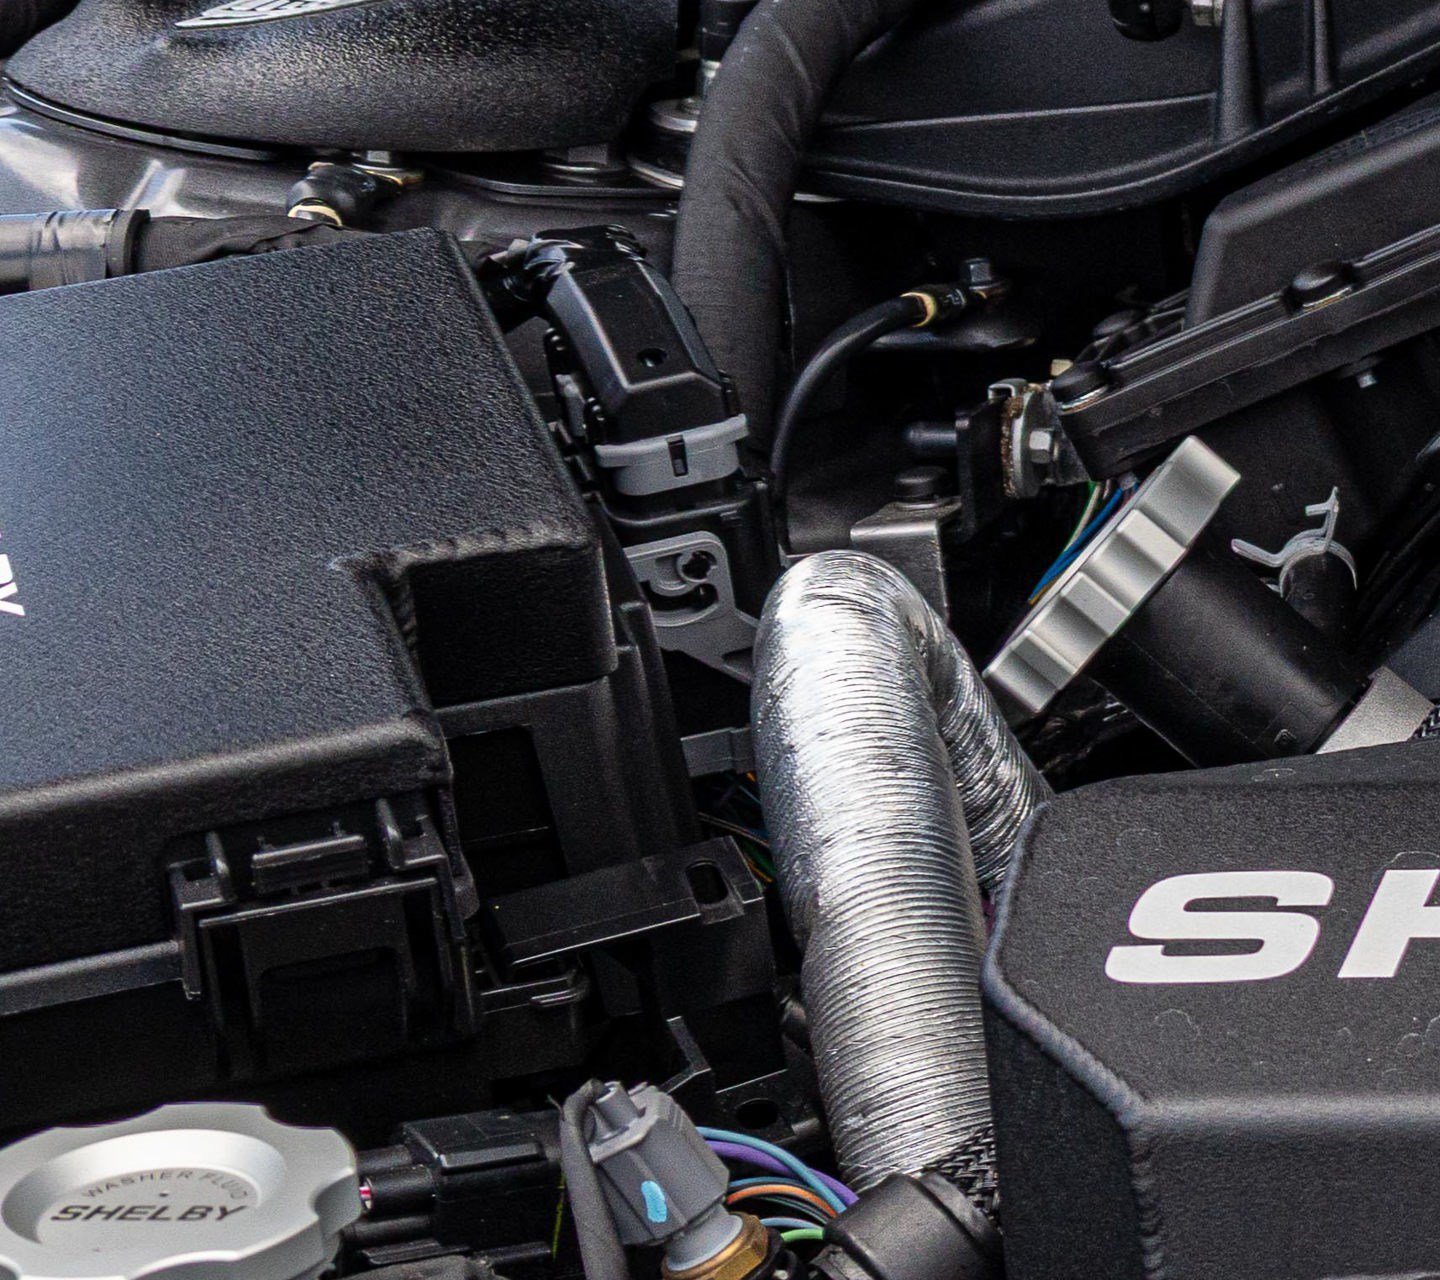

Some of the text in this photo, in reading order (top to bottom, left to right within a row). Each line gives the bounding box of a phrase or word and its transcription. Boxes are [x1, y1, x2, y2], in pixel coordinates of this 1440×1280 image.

[83, 1170, 249, 1200] WASHER FLUID
[50, 1204, 249, 1222] SHELBY
